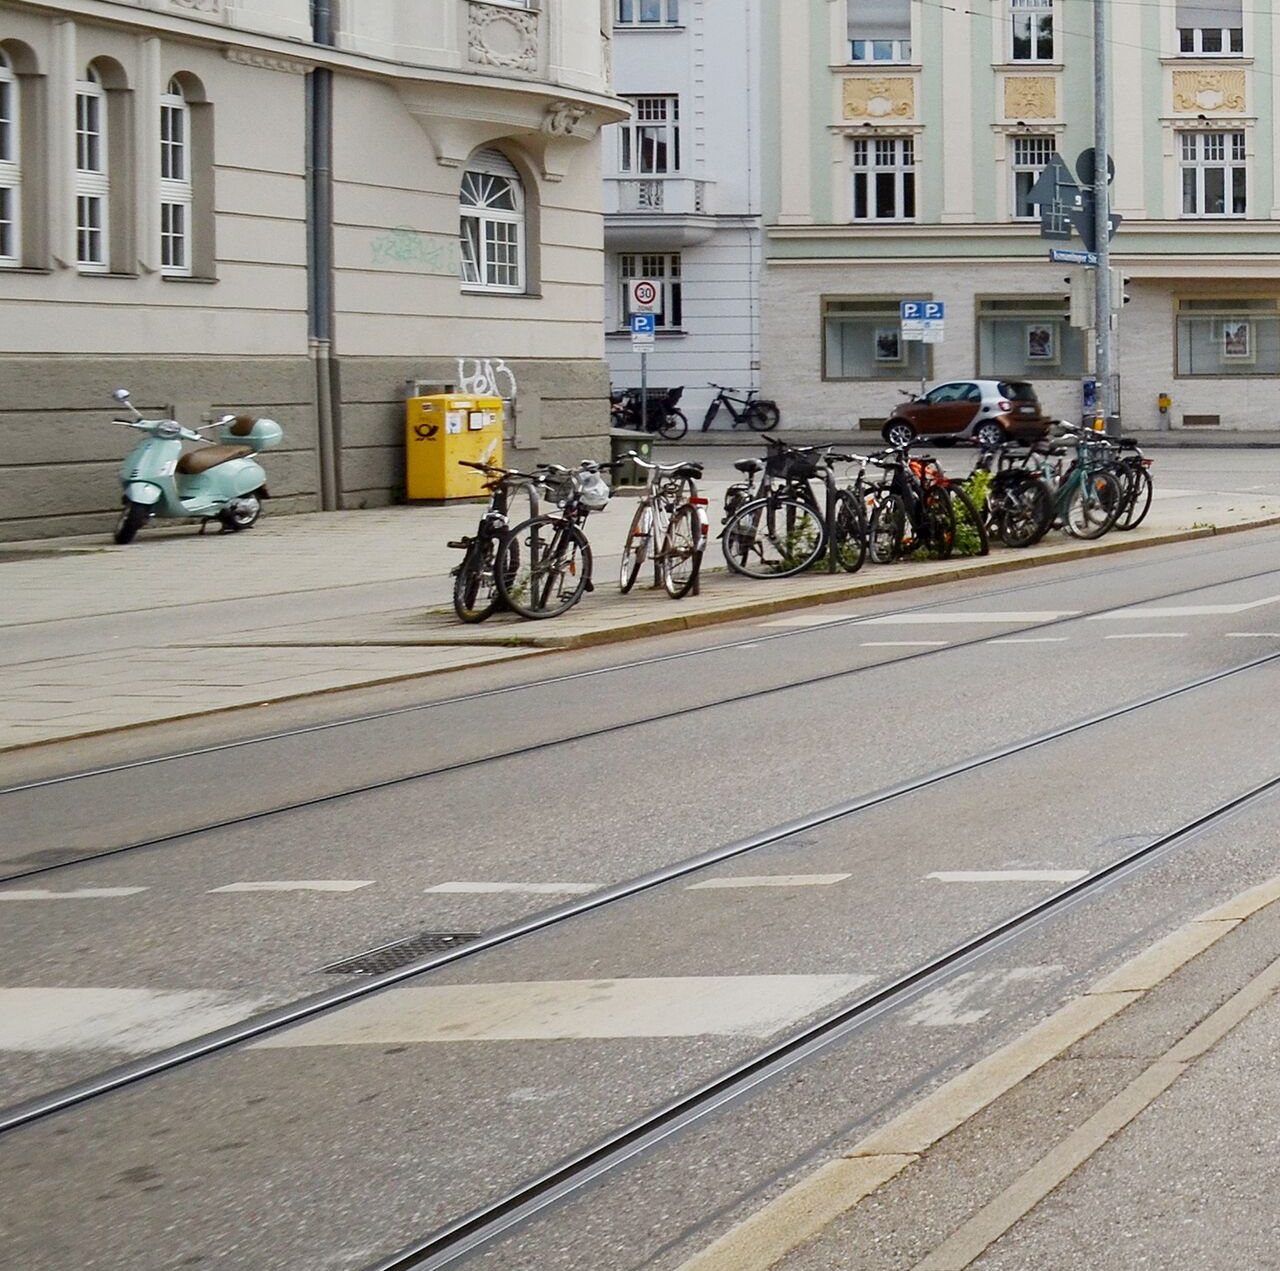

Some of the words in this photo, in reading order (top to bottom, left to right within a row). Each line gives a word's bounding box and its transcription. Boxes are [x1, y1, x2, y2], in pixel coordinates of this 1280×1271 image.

[639, 288, 651, 299] 30
[904, 303, 918, 318] P
[925, 303, 939, 318] P
[634, 317, 648, 331] P
